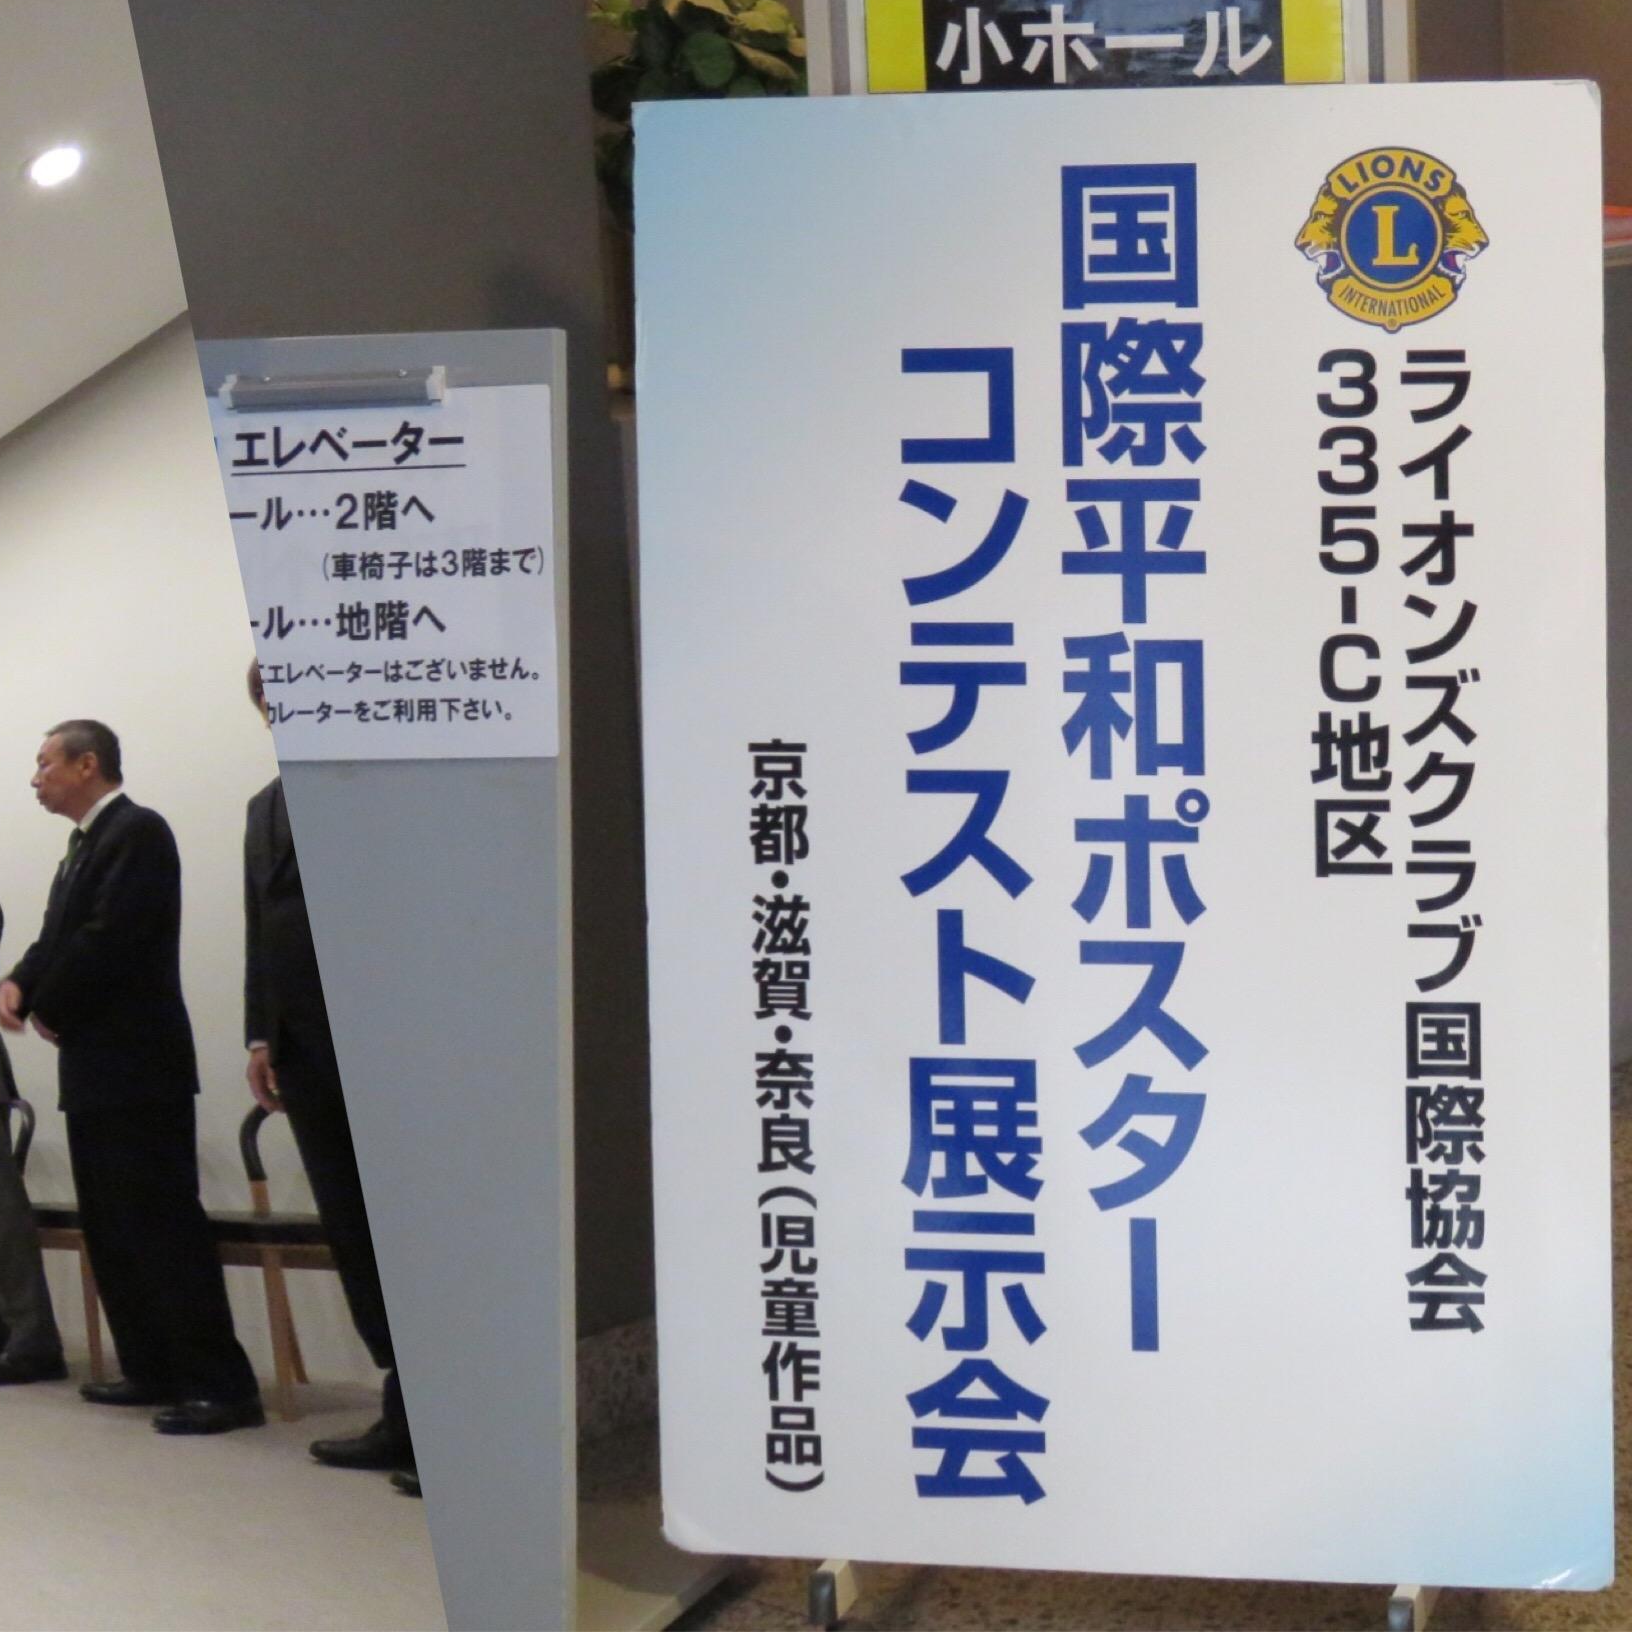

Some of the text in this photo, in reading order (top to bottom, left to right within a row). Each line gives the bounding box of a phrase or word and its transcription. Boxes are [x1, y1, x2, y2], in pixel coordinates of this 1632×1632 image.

[935, 3, 1273, 86] 小ホール
[1336, 154, 1446, 194] LIONS
[1371, 205, 1419, 265] L
[1338, 284, 1446, 317] INTERNATIONAL
[231, 421, 465, 468] エレベーター
[1060, 162, 1211, 1353] 国際平和ポスター
[1399, 349, 1487, 1335] ライオンズクラブ国際協会
[899, 346, 1051, 1506] コンテスト展示会
